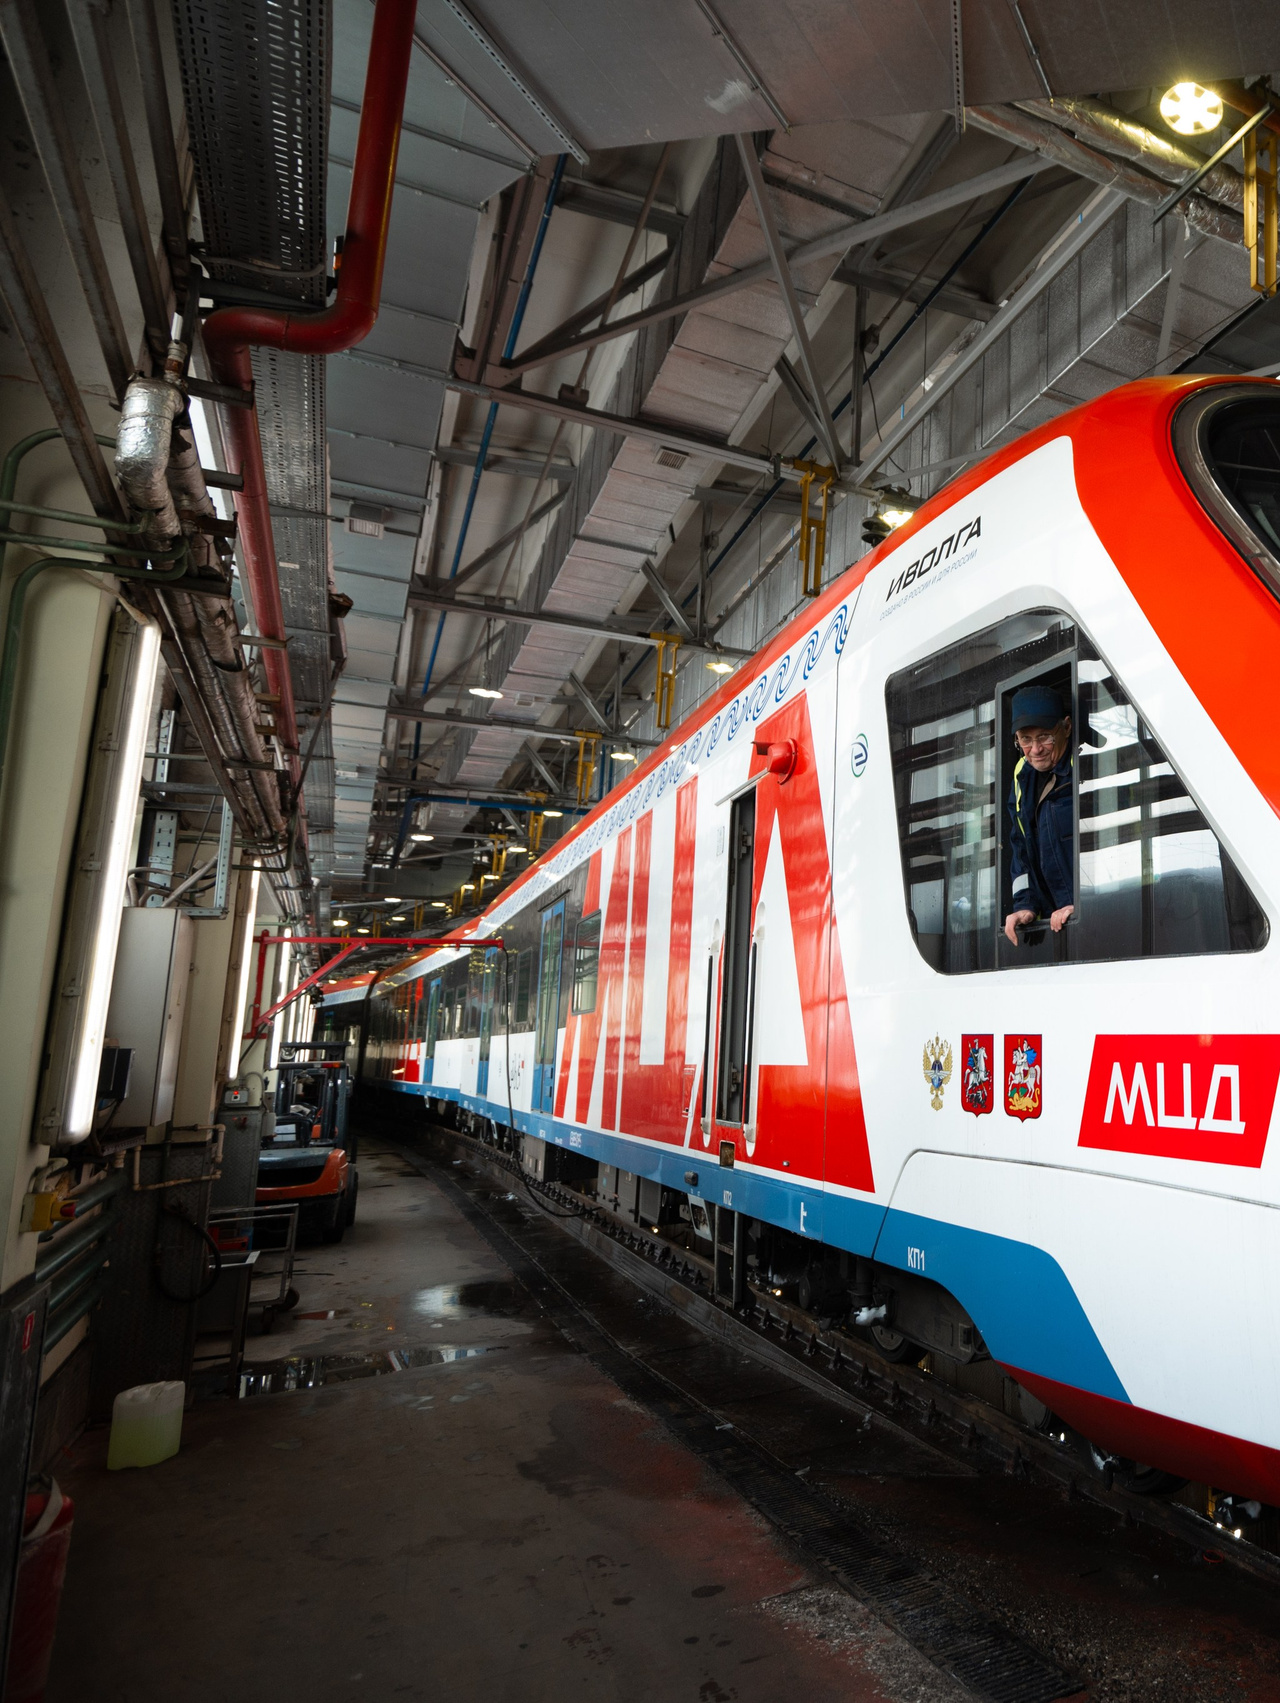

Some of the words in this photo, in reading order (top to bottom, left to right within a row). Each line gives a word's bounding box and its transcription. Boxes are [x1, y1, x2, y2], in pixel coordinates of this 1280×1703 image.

[885, 515, 982, 602] ИВОЛГА
[1103, 1062, 1246, 1135] МЦД
[907, 1246, 925, 1271] КП1
